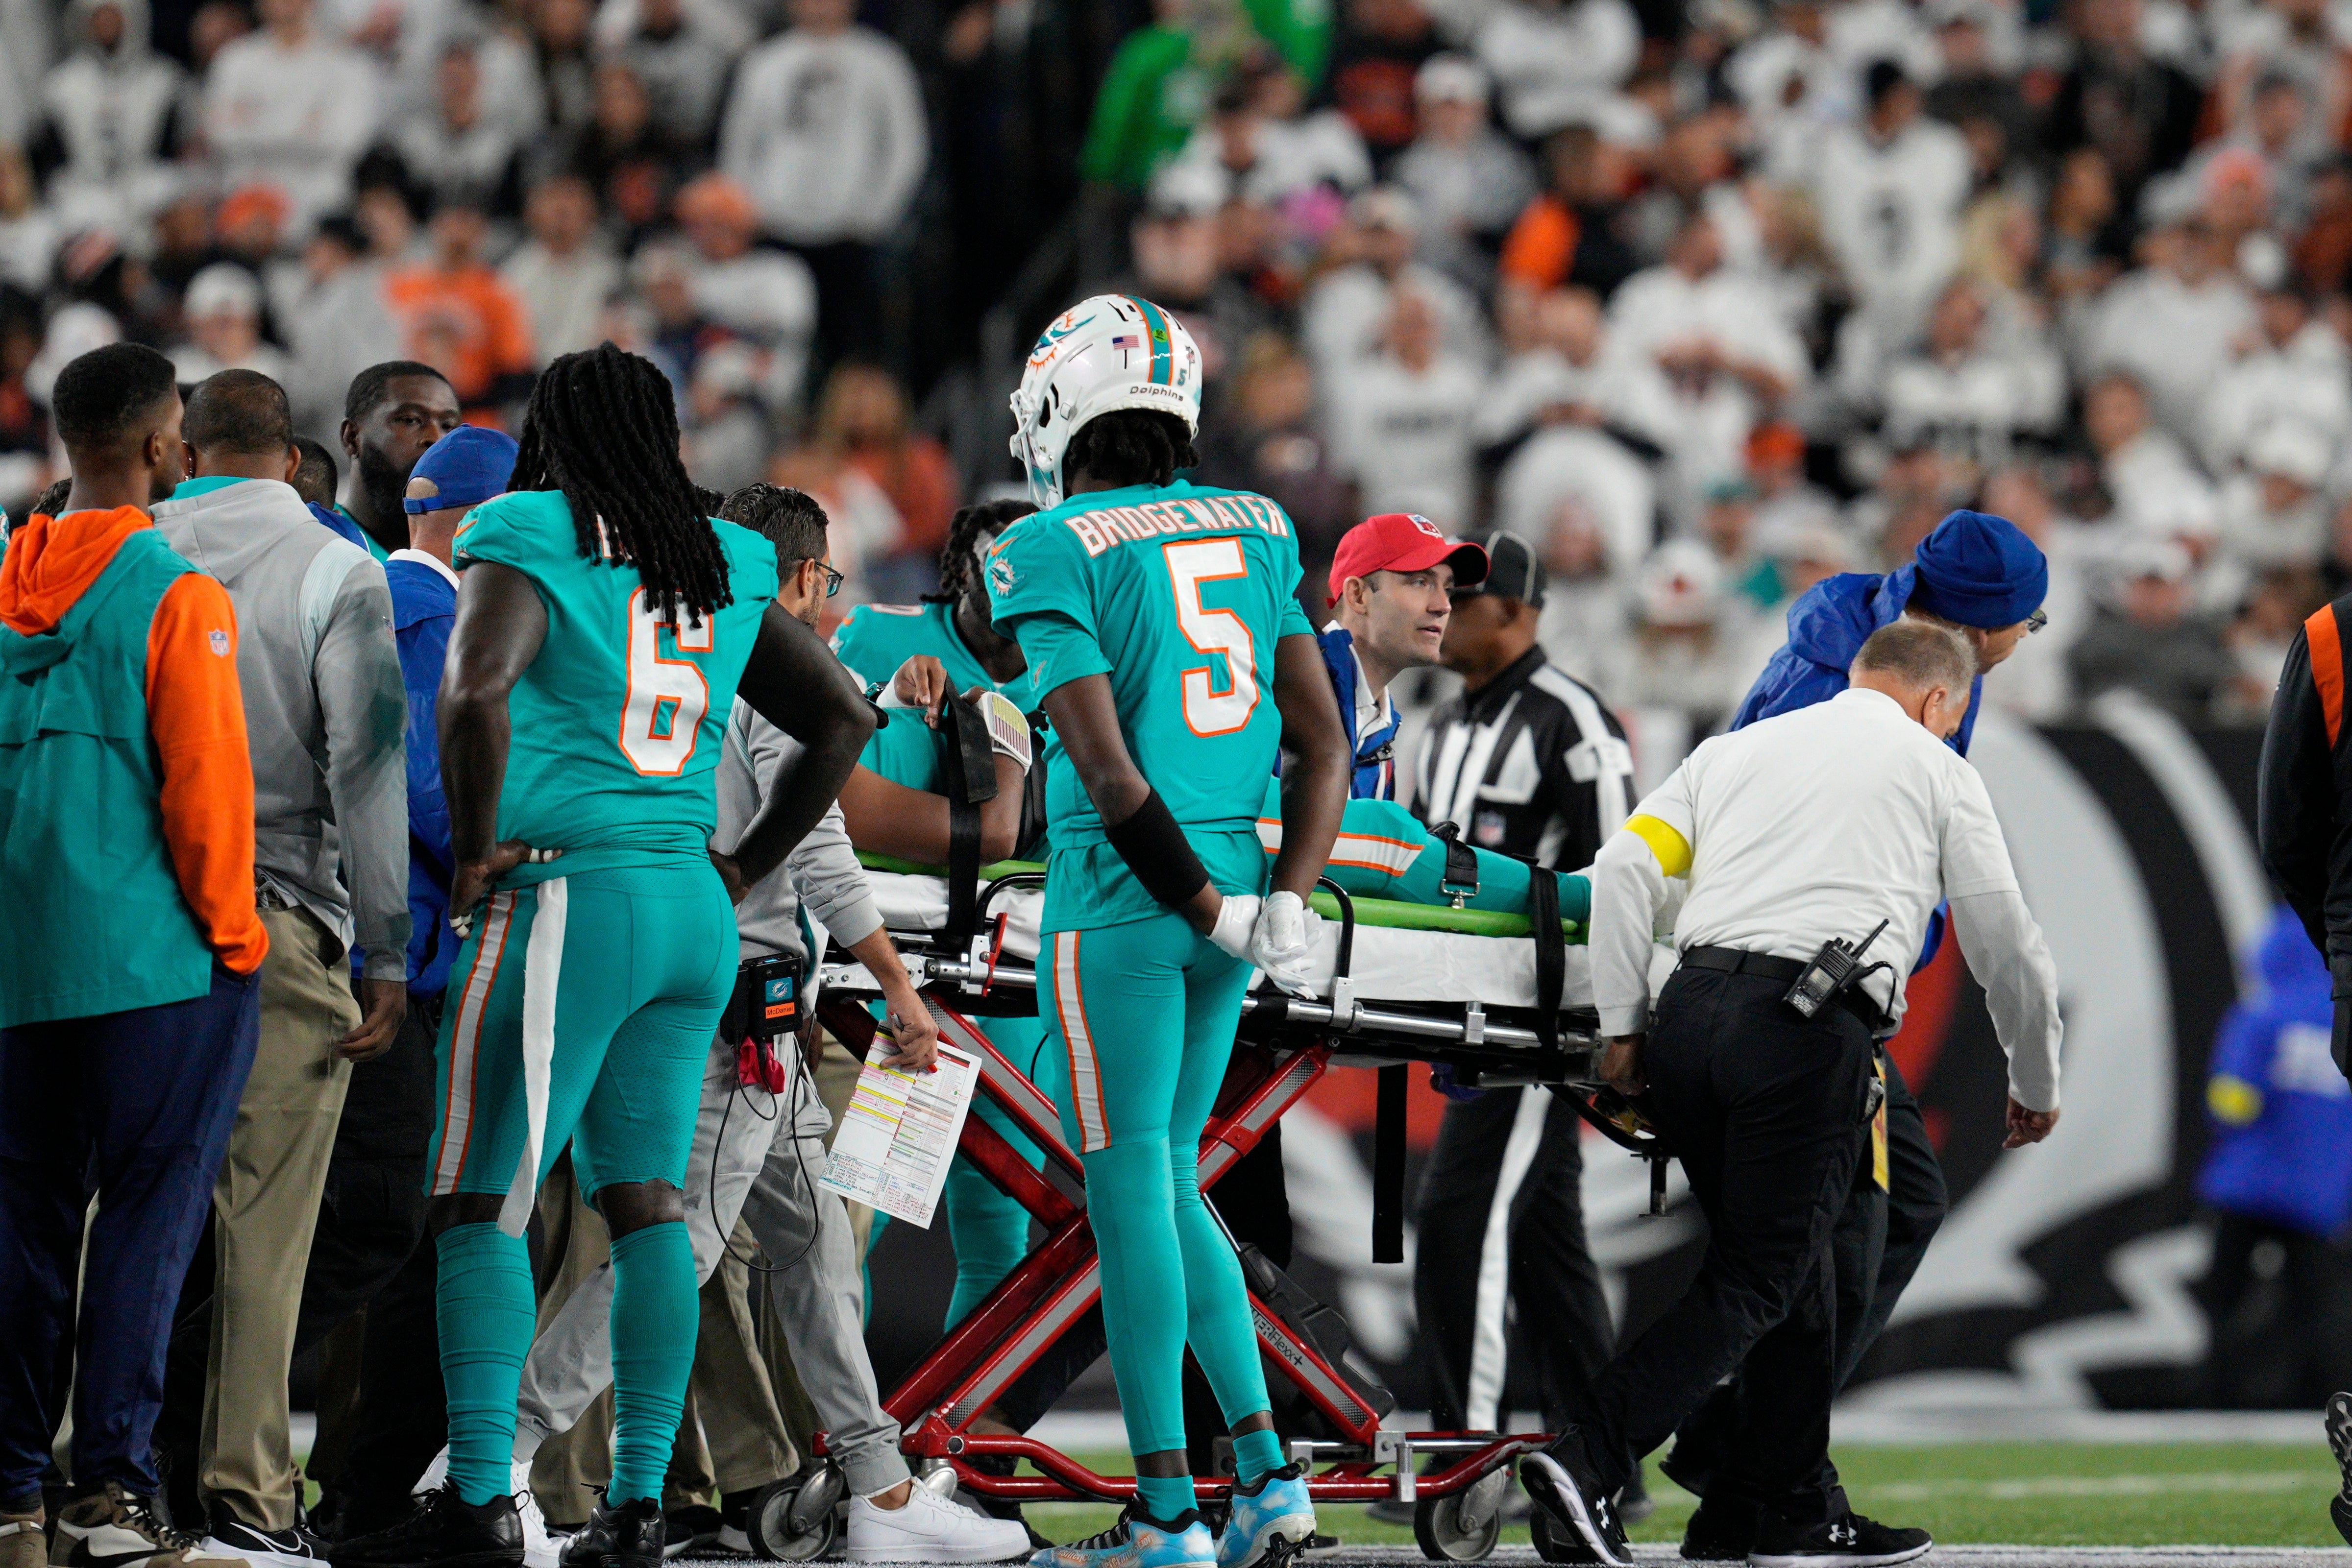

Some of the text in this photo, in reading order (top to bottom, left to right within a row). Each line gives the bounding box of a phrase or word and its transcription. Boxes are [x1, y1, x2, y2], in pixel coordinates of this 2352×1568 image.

[1129, 386, 1184, 402] Dolphins
[1177, 367, 1187, 386] 5
[1064, 495, 1289, 558] BRIDGEWATER
[1162, 536, 1260, 738] 5
[618, 584, 713, 776] 6
[767, 1005, 793, 1016] McDaniel
